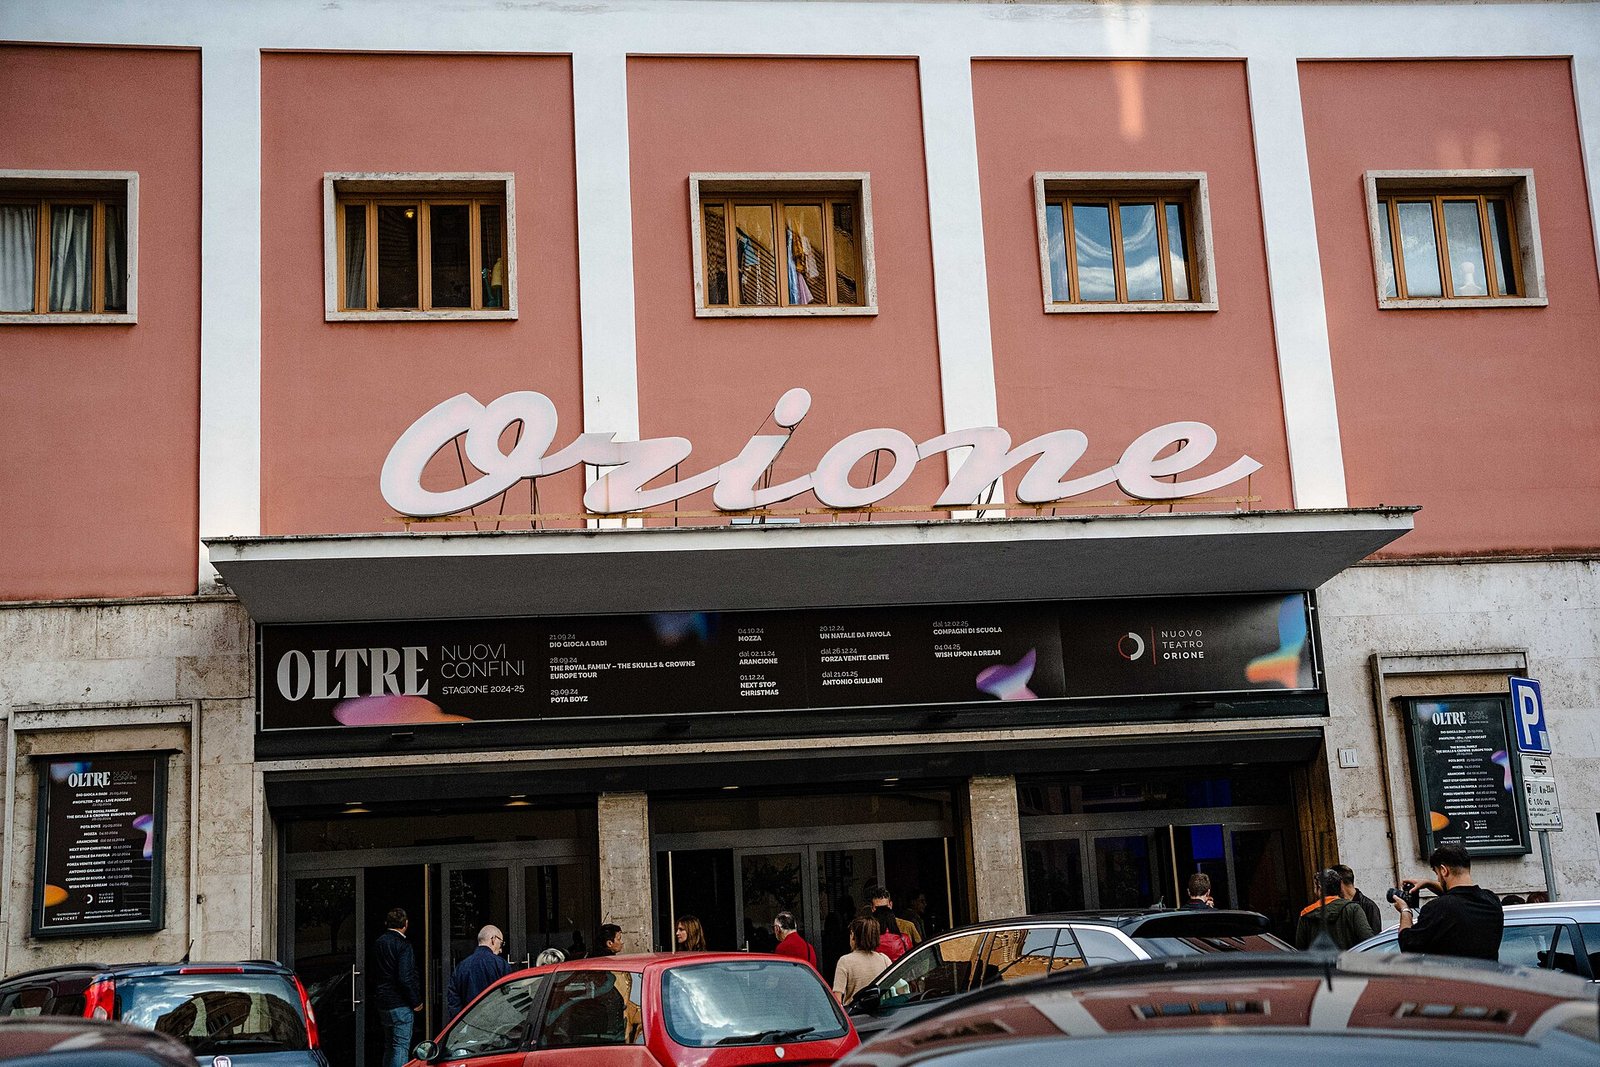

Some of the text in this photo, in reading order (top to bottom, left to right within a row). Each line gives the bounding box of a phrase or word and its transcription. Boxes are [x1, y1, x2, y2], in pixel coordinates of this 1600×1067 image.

[379, 388, 1264, 517] Orione
[442, 644, 506, 661] NUOVI
[277, 647, 429, 701] OLTRE
[441, 660, 525, 678] CONFINI
[442, 685, 525, 695] STAGIONE 2024-25
[1432, 712, 1467, 726] OLTRE
[1518, 685, 1539, 744] P
[68, 772, 110, 788] OLTRE
